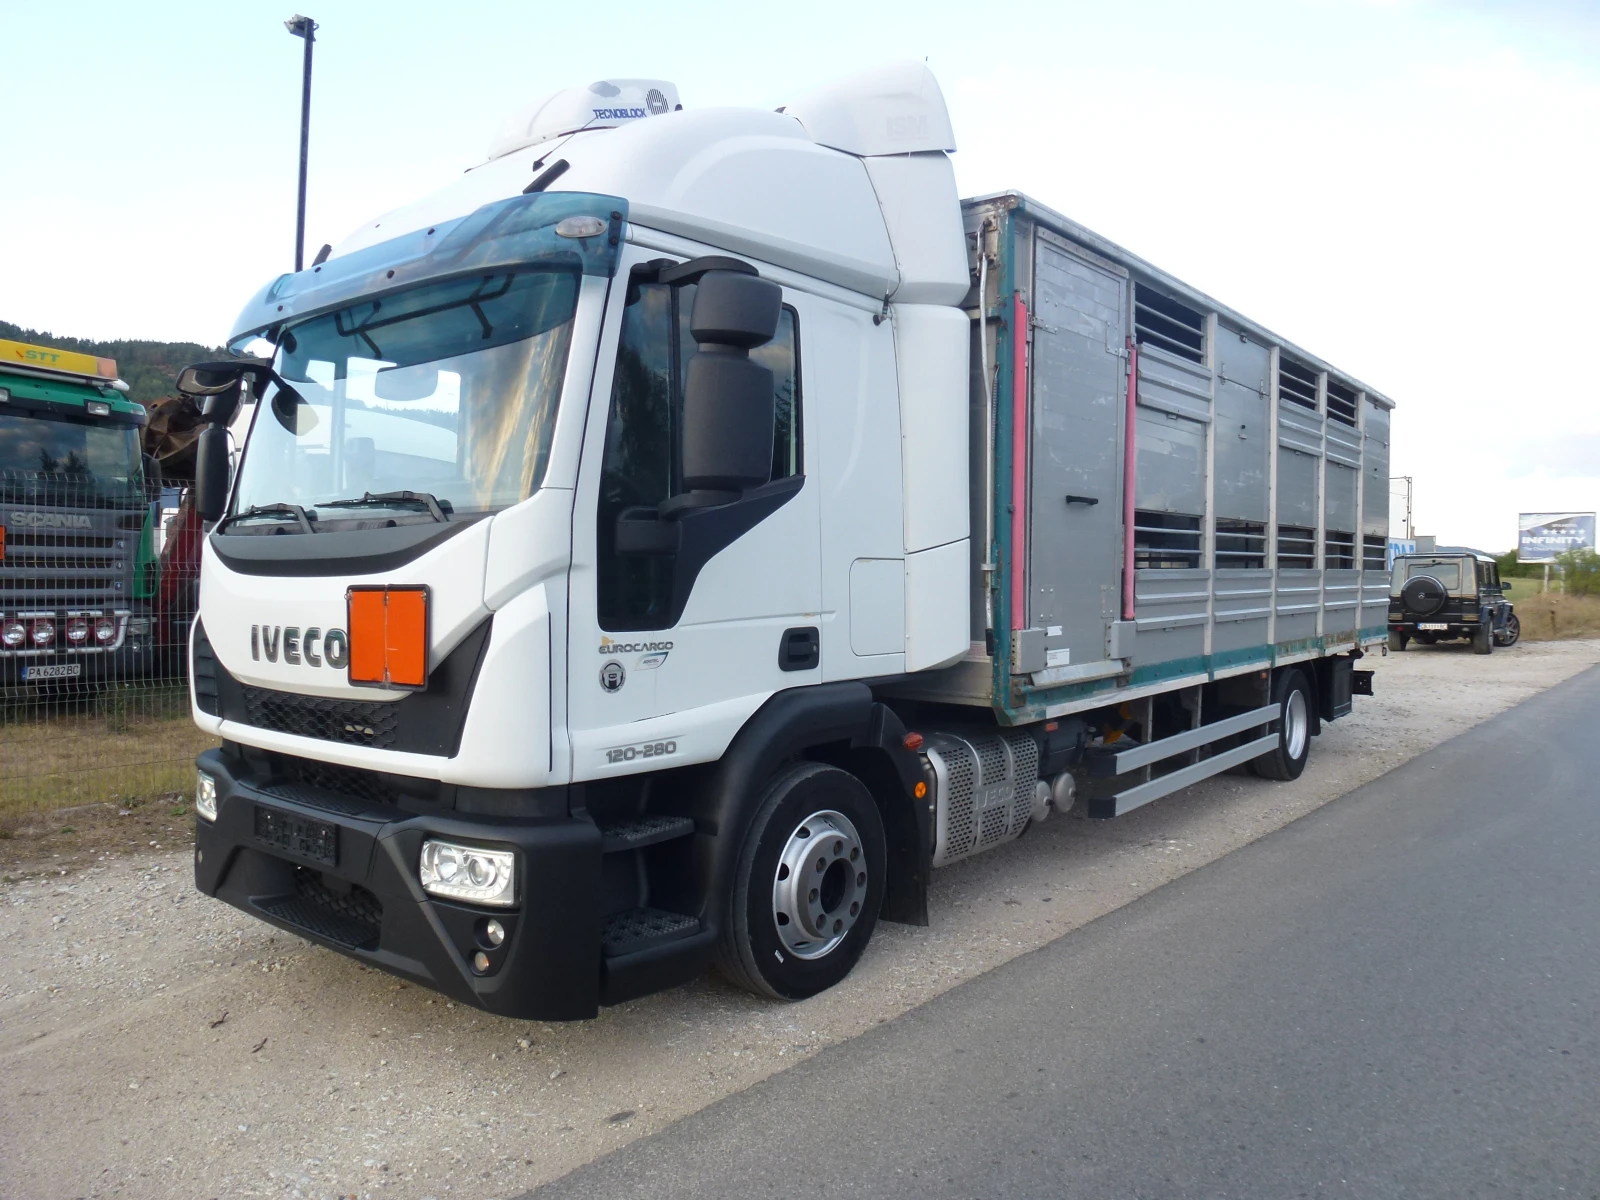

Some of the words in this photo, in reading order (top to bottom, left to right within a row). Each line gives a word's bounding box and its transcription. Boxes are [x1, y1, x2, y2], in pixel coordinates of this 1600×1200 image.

[592, 108, 647, 119] TECNOBLOCK
[25, 350, 60, 363] STT
[10, 511, 93, 530] SCANIA
[1521, 536, 1586, 544] INFINITY
[251, 624, 349, 670] IVECO
[598, 641, 674, 655] EUROCARGO
[606, 740, 677, 764] 120-280
[974, 786, 1014, 811] IVECO
